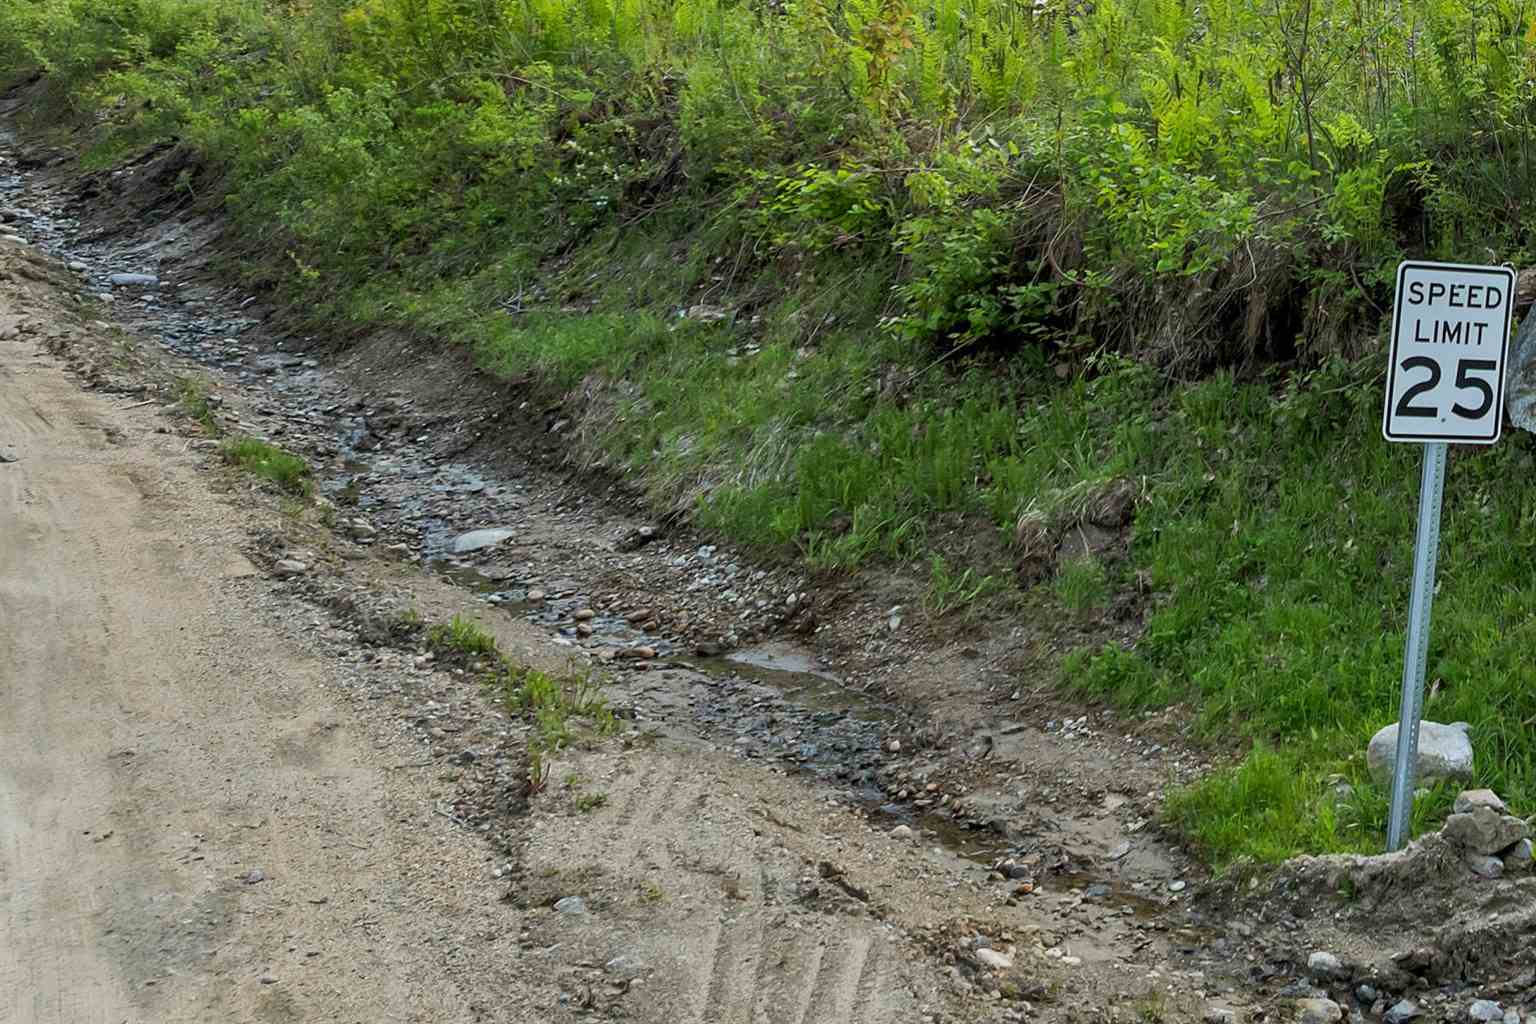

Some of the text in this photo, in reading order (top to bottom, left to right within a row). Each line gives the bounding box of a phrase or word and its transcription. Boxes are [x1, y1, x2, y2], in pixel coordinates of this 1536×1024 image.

[1408, 281, 1502, 309] SPEED
[1414, 319, 1488, 346] LIMIT
[1395, 356, 1497, 420] 25
